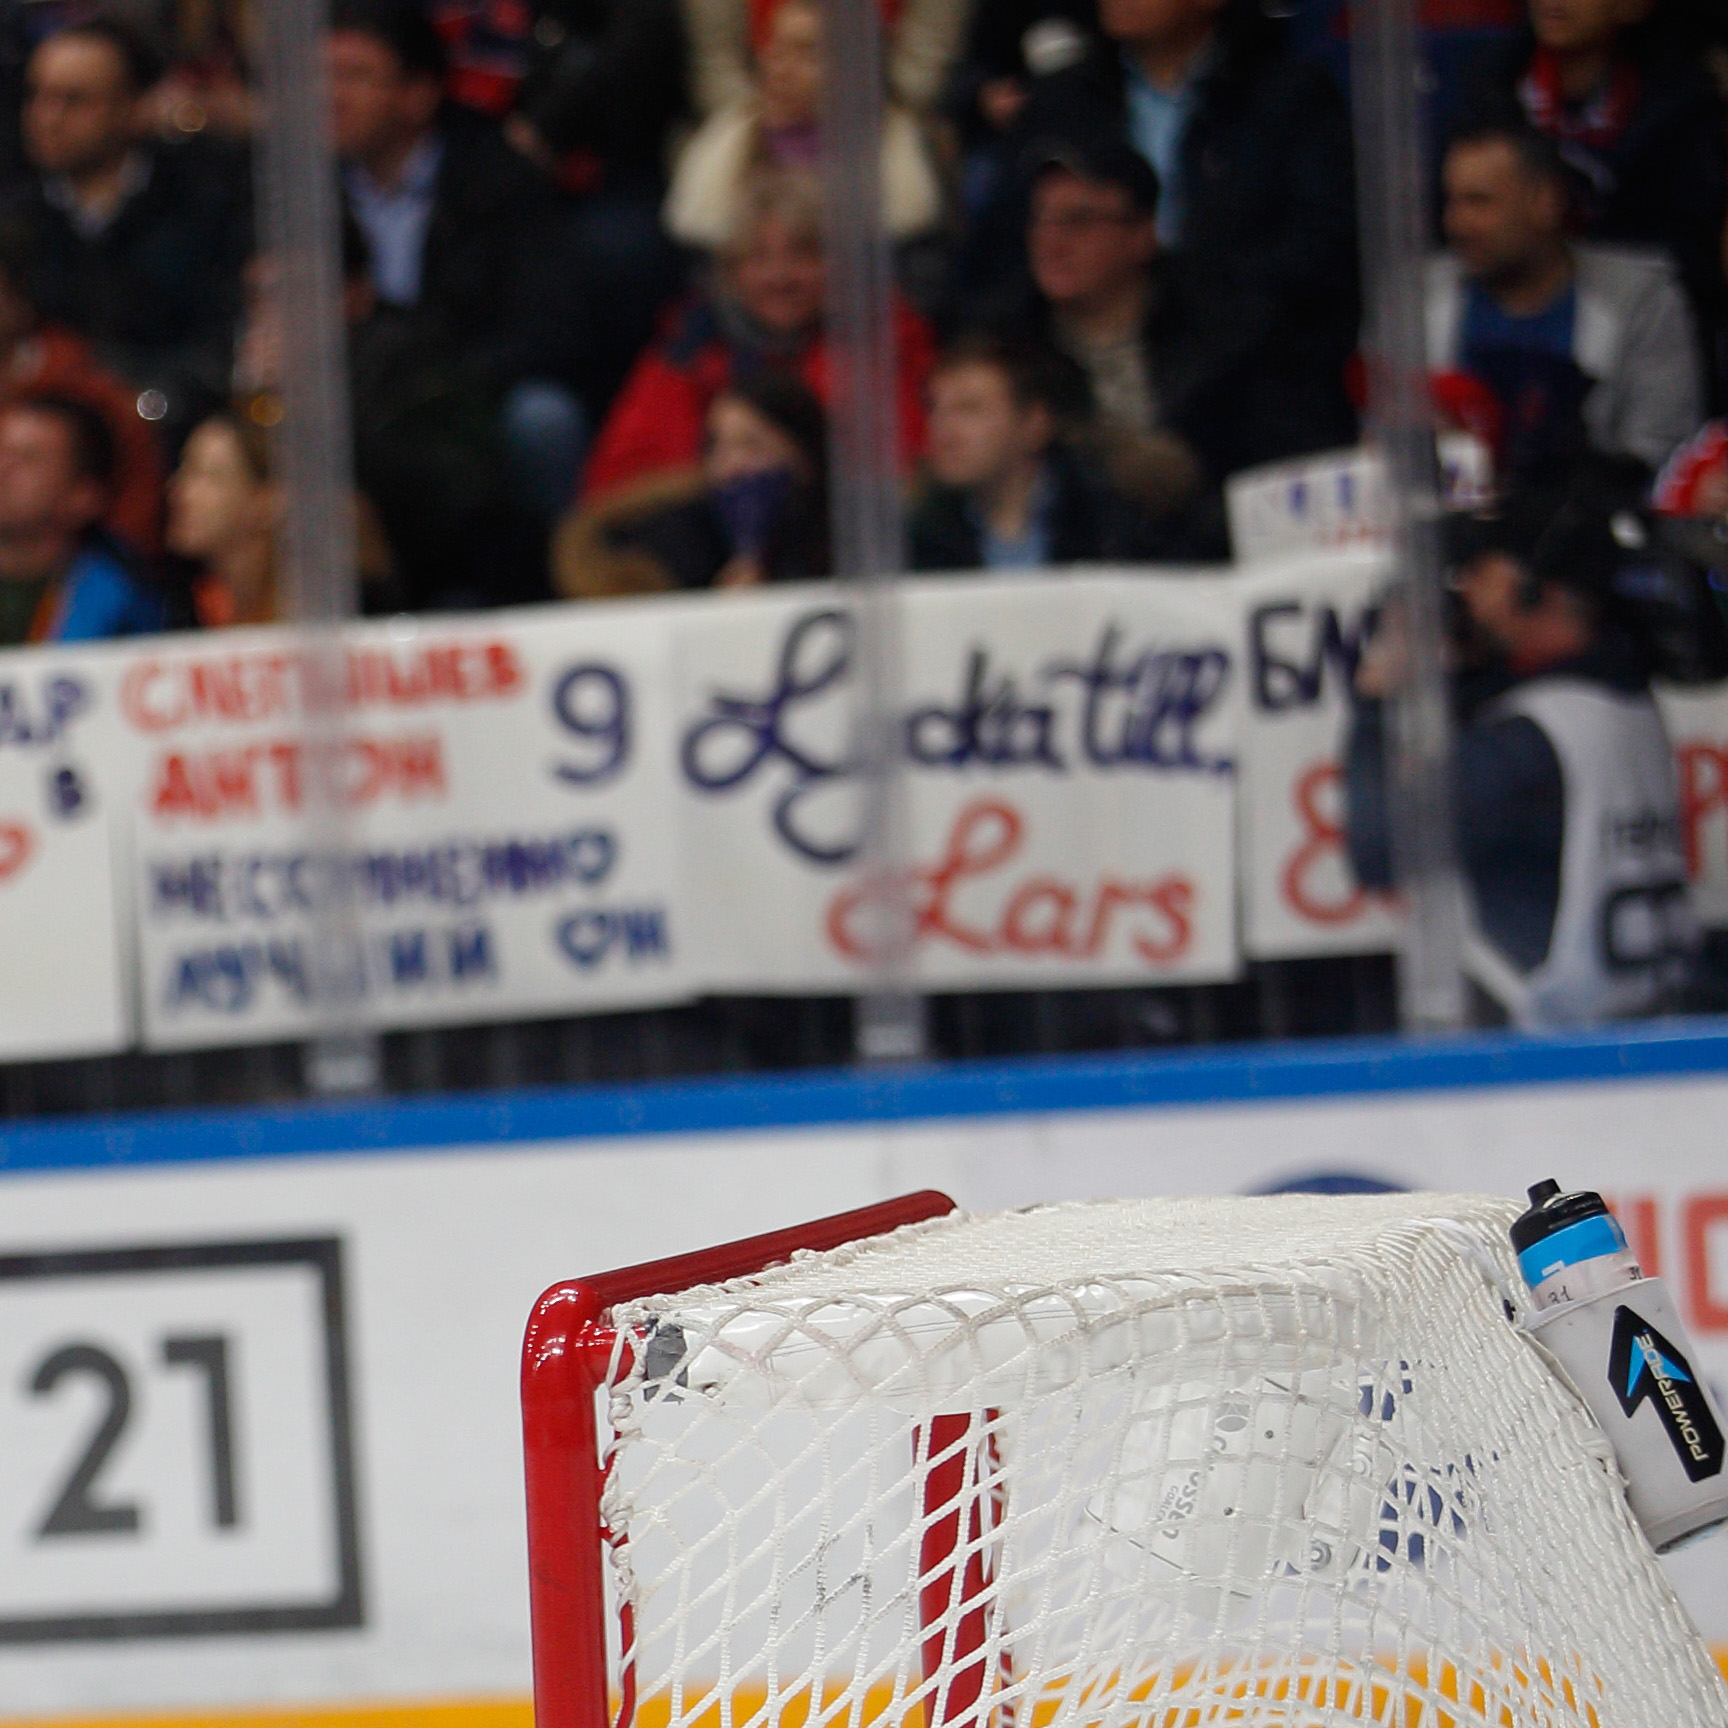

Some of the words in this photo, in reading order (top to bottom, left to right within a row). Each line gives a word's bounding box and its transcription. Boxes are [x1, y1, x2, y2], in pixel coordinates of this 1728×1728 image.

[546, 656, 637, 790] 9
[821, 792, 1200, 966] Lars
[26, 1325, 243, 1541] 21
[1634, 1330, 1710, 1463] POWERADE
